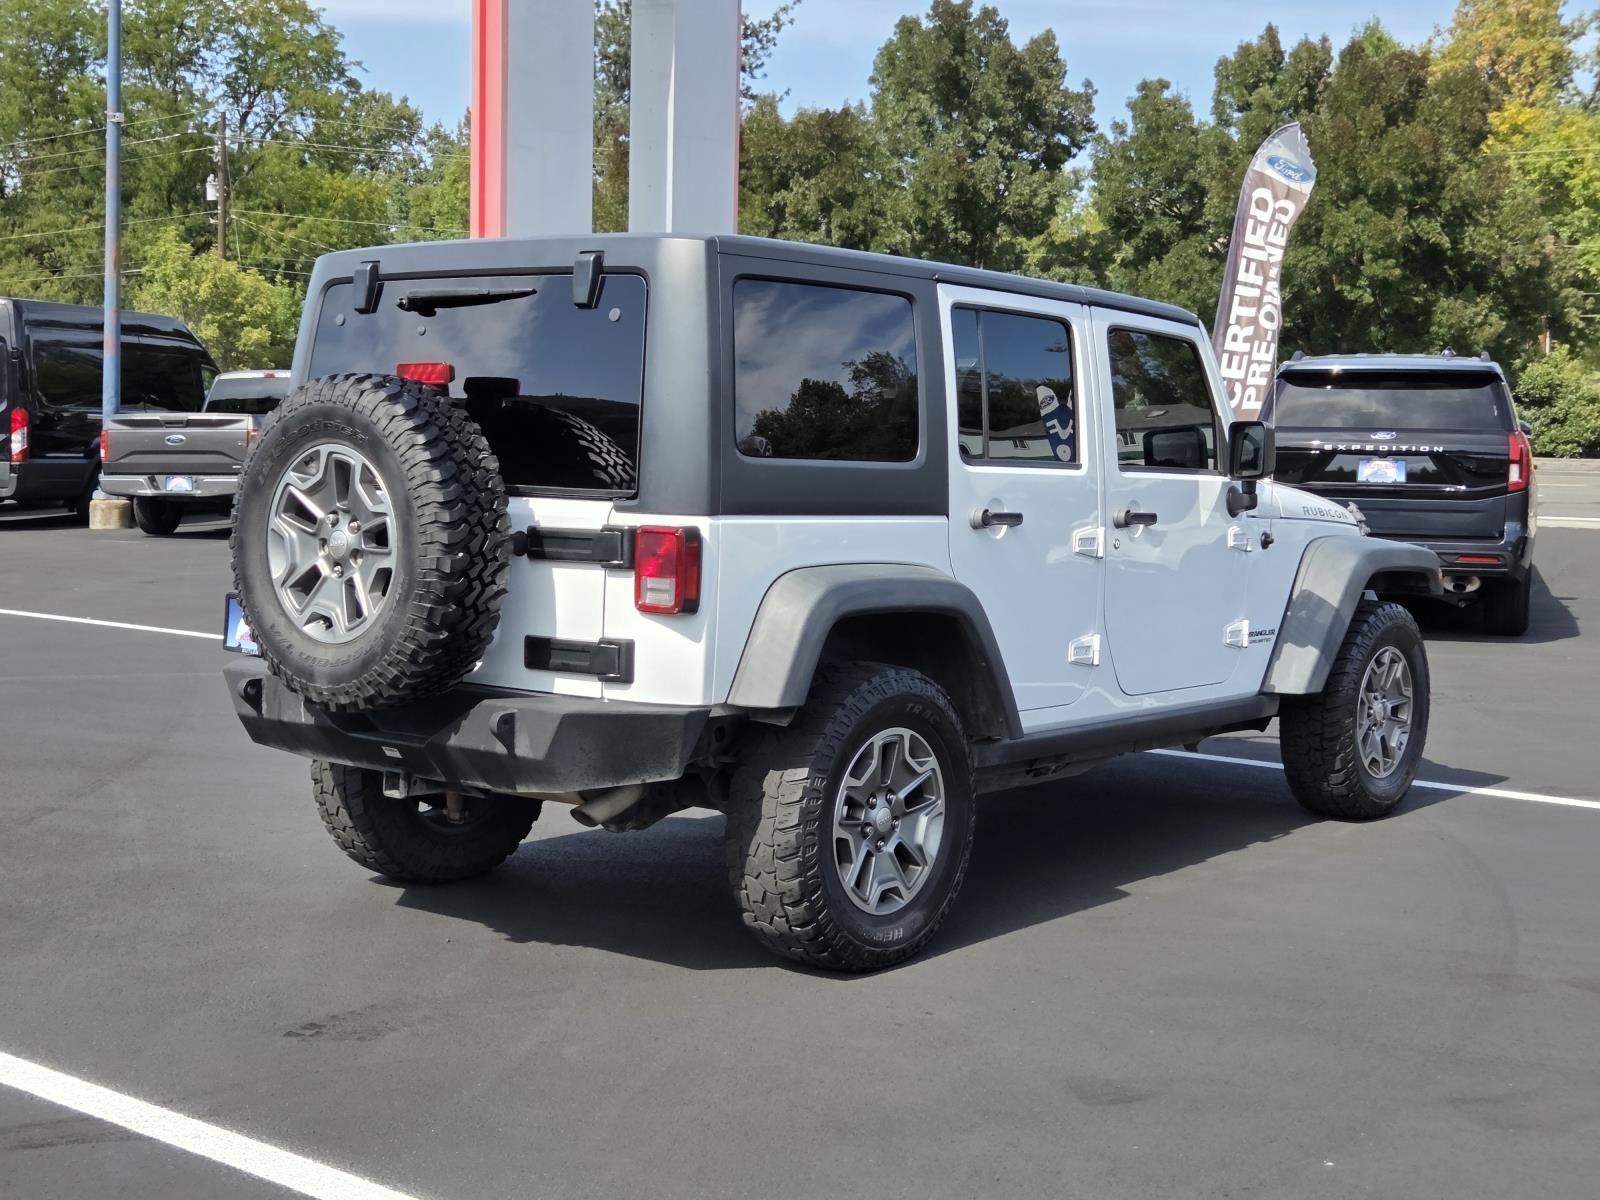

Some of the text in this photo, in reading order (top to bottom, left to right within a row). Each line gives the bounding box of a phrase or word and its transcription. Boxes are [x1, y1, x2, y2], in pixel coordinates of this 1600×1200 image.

[1220, 187, 1274, 409] CERTIFIED
[1242, 199, 1296, 410] PRE-OWNED
[1323, 444, 1444, 452] EXPEDITION
[1302, 506, 1349, 519] RUBICON
